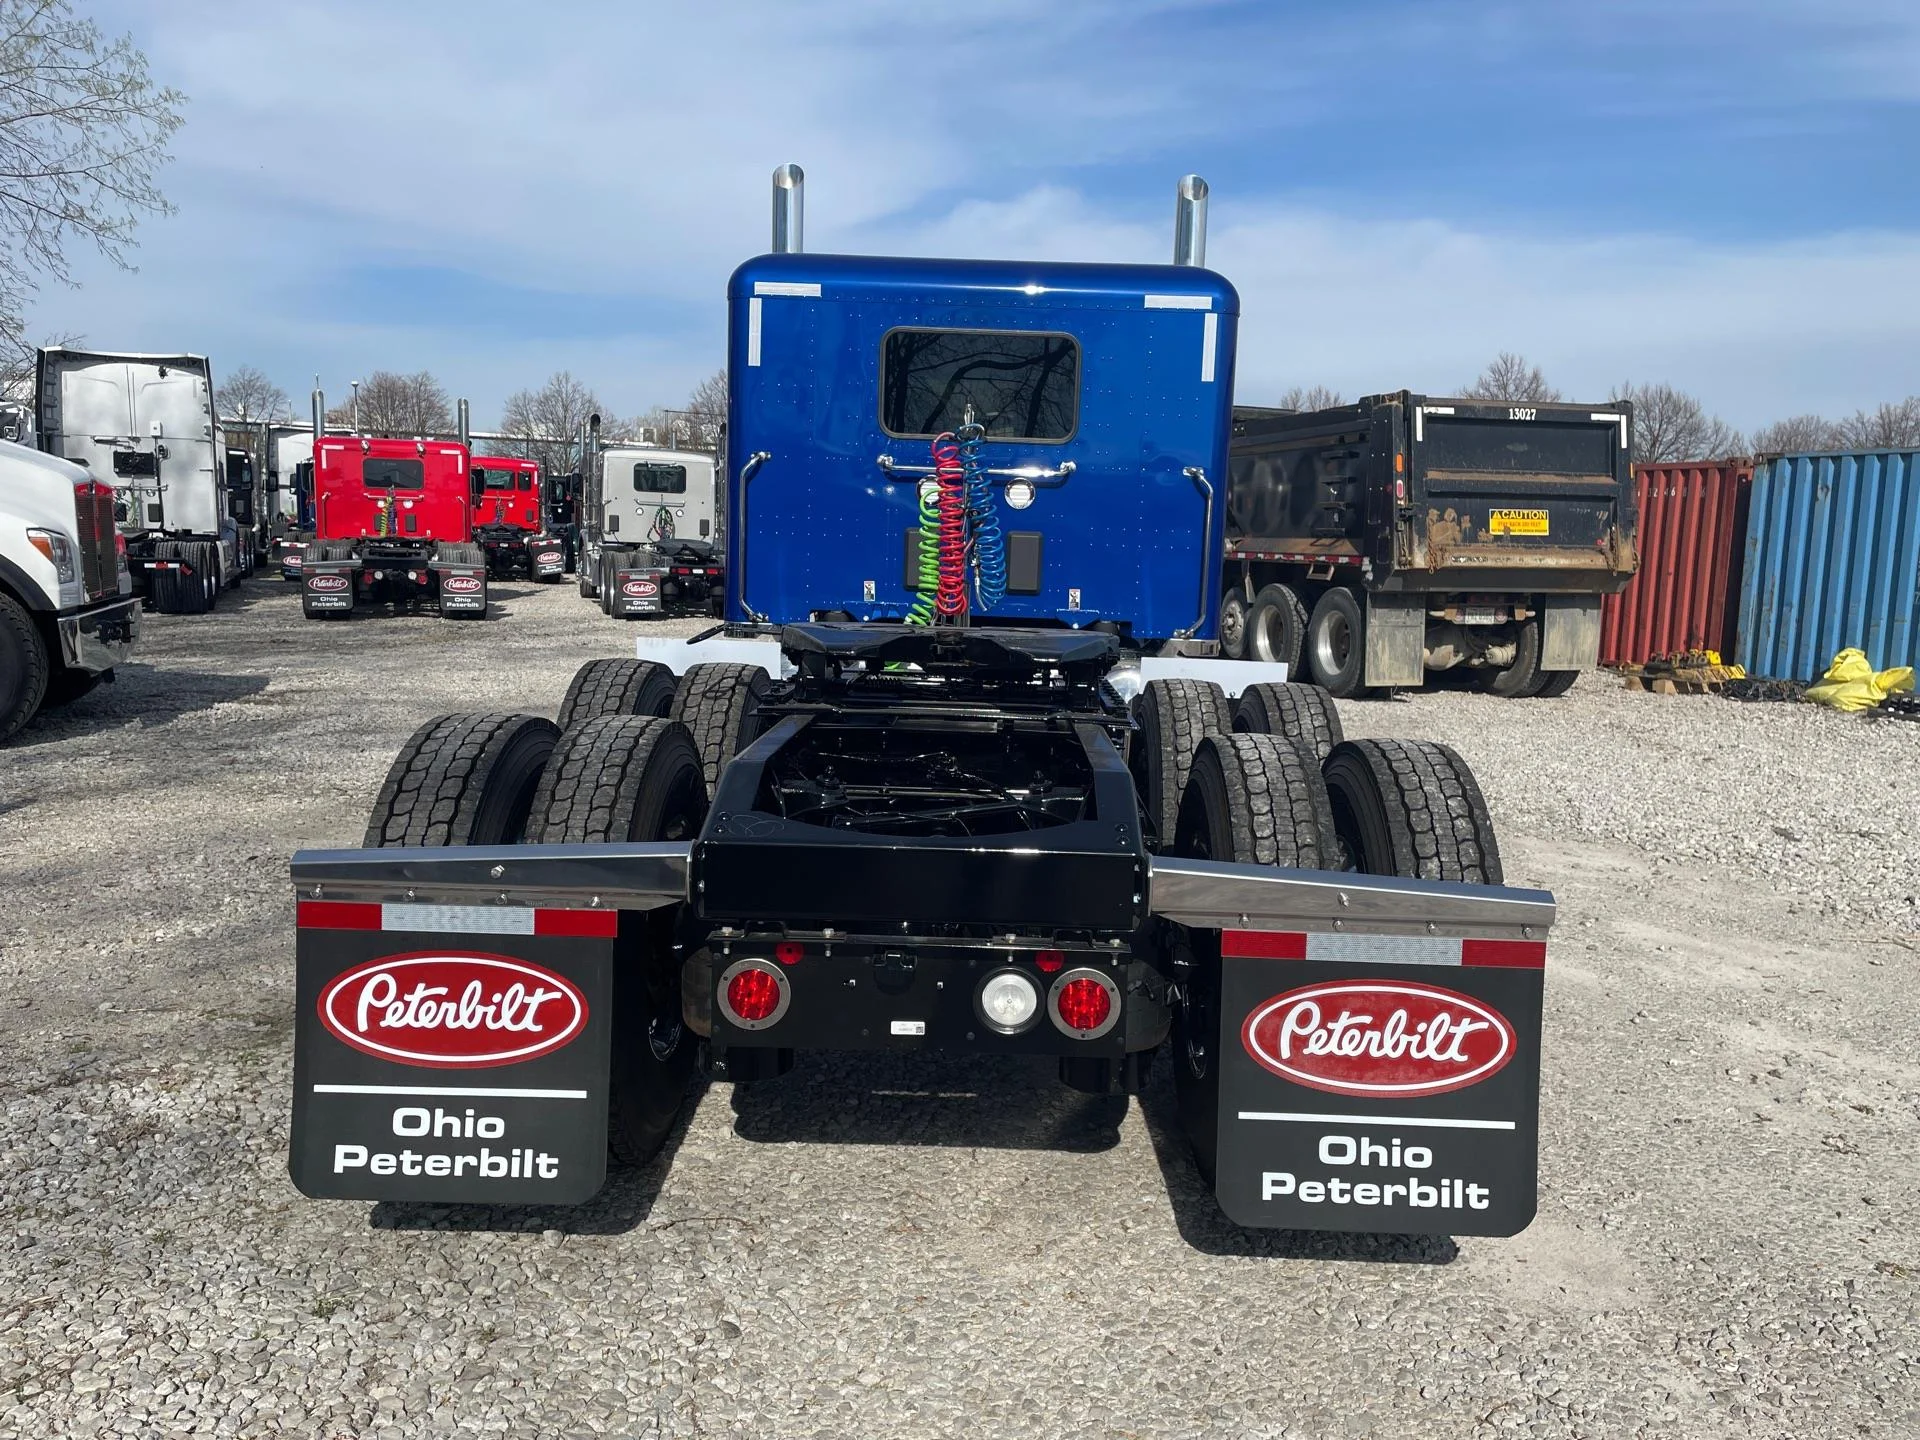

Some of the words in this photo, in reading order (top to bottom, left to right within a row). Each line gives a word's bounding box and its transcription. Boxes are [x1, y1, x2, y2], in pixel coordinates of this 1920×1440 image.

[1509, 407, 1537, 421] 13027
[1502, 510, 1546, 519] CAUTION
[313, 578, 344, 588] Peterbilt
[448, 579, 479, 588] Peterbilt
[627, 583, 655, 592] Peterbilt
[357, 973, 563, 1033] Peterbilt
[1279, 1000, 1489, 1062] Peterbilt
[392, 1107, 505, 1139] Ohio
[333, 1144, 559, 1179] Peterbilt
[1318, 1135, 1433, 1169] Ohio
[1262, 1171, 1490, 1210] Peterbilt
